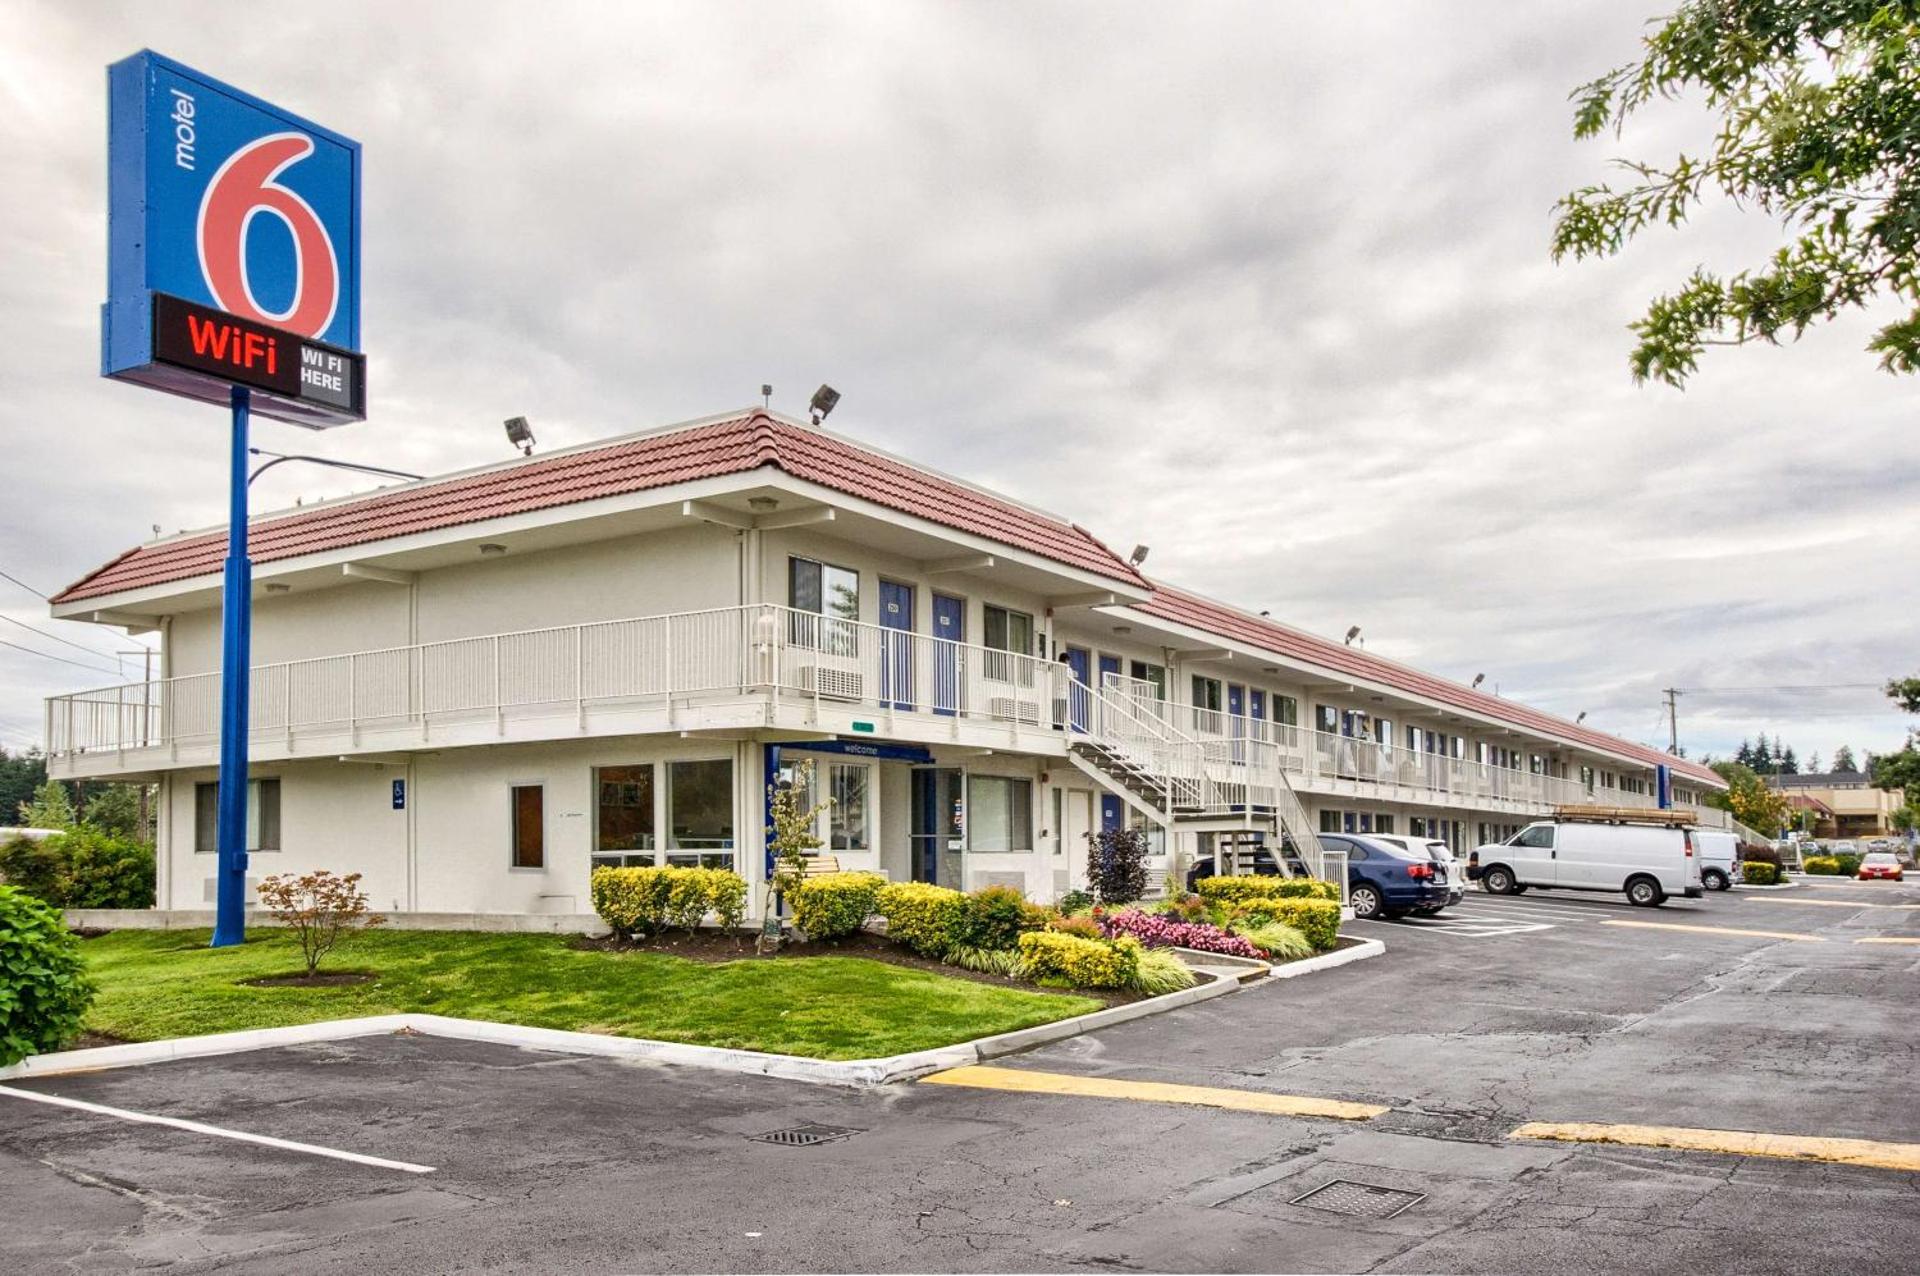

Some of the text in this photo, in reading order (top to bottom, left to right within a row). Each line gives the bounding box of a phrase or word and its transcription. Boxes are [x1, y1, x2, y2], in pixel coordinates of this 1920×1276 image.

[171, 88, 195, 171] motel
[197, 132, 339, 340] 6
[188, 315, 275, 374] WiFi
[301, 346, 342, 373] WI FI
[301, 367, 342, 391] HERE
[845, 744, 878, 755] welcome
